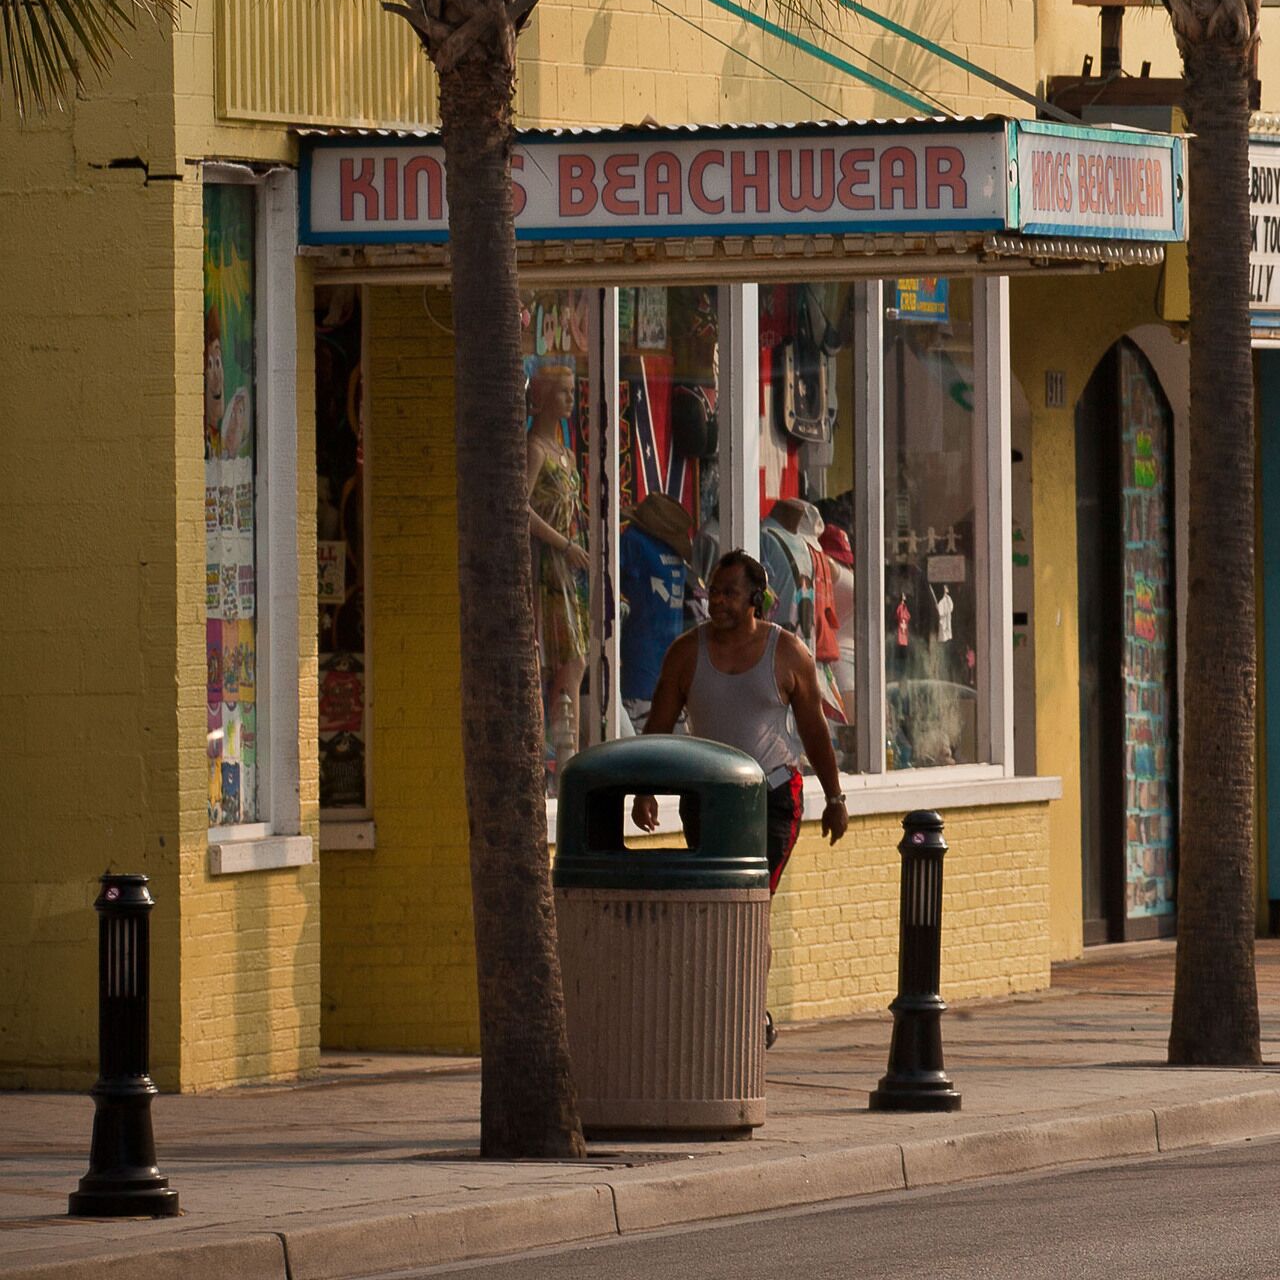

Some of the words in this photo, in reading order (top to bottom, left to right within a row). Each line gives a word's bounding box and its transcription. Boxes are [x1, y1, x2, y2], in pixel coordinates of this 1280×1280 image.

[340, 154, 529, 221] KIN
[558, 145, 968, 217] BEACHWEAR
[1031, 150, 1073, 213] KINGS
[1077, 153, 1164, 218] BEACHWEAR
[1251, 166, 1280, 205] BODY
[1250, 264, 1275, 303] LLY
